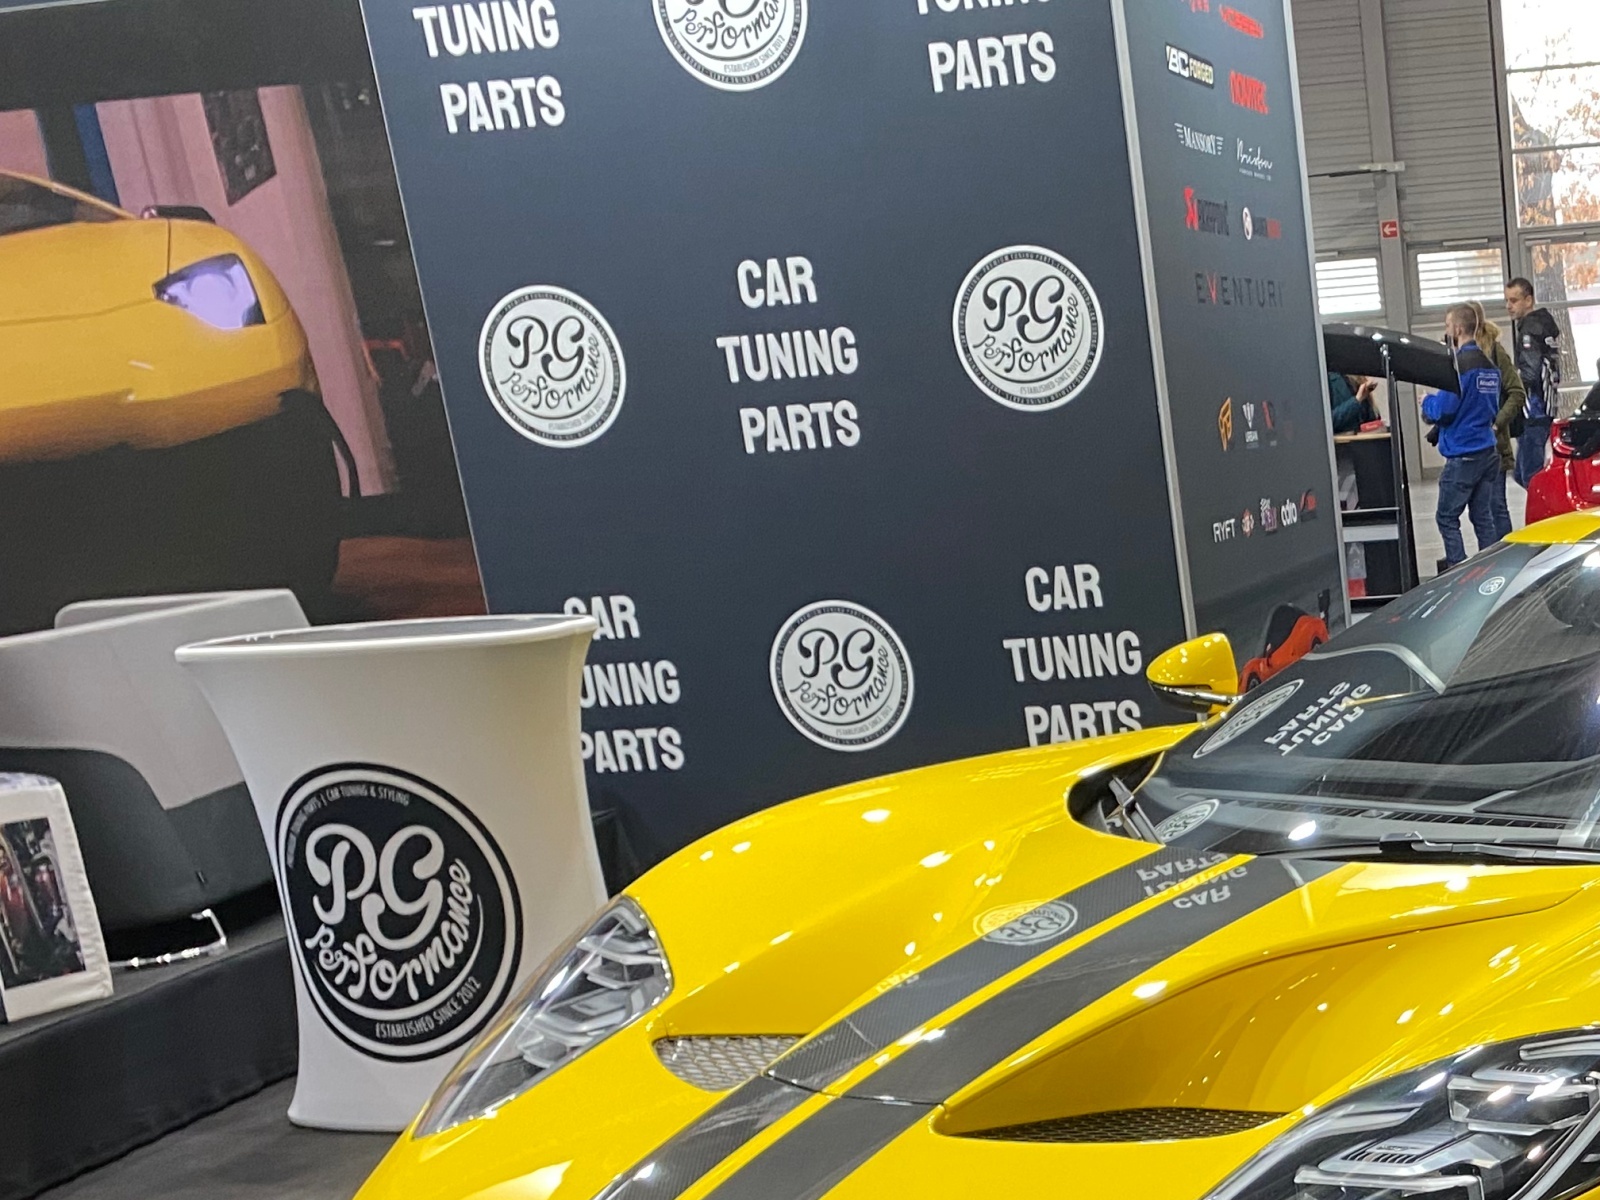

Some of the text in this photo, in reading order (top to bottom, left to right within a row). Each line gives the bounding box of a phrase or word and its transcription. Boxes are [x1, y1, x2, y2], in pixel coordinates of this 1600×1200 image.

[412, 0, 559, 57] TUNING
[928, 31, 1056, 93] PARTS
[440, 75, 565, 134] PARTS
[737, 256, 818, 309] CAR
[982, 275, 1065, 344] PG
[506, 315, 585, 382] PG
[716, 326, 859, 383] TUNING
[973, 293, 1079, 373] Performance
[500, 333, 600, 410] Performance
[739, 400, 861, 454] PARTS
[1212, 518, 1236, 543] RYFT
[1024, 563, 1104, 612] CAR
[580, 659, 682, 709] UNING
[790, 645, 890, 716] Performance
[797, 627, 875, 690] PG
[1002, 630, 1142, 682] TUNING
[305, 823, 445, 950] PG
[305, 859, 474, 1000] Performance
[375, 1015, 436, 1039] ESTABLISHED
[433, 996, 463, 1025] SINCE
